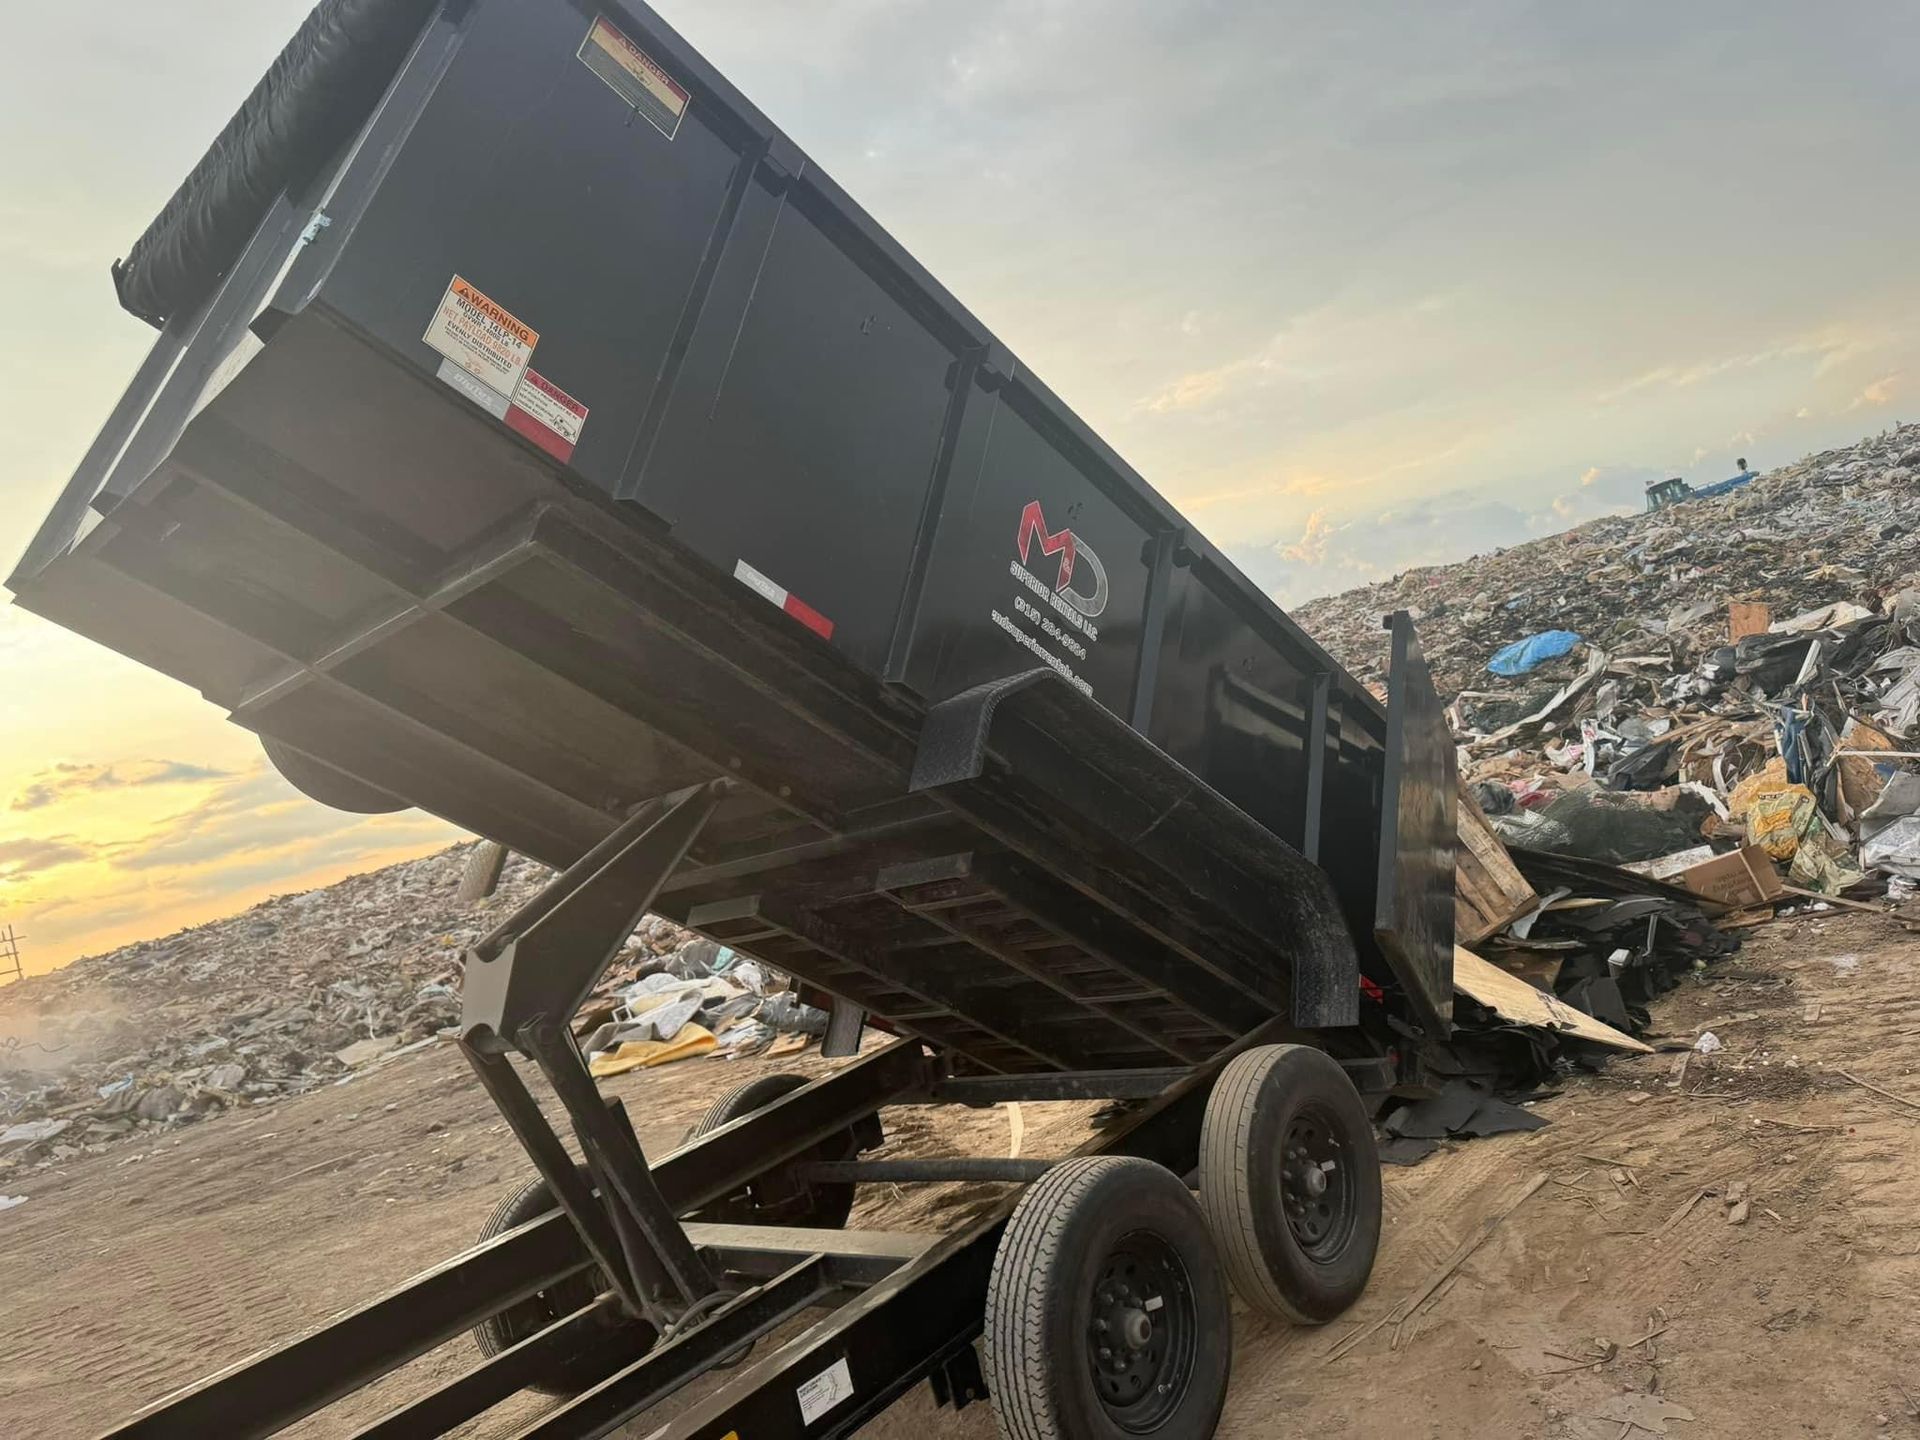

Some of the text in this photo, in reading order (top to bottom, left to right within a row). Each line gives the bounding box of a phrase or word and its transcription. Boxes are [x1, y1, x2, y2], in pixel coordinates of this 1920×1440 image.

[627, 44, 669, 85] DANGER
[442, 305, 458, 321] NET
[457, 316, 492, 346] PAYLOAD
[455, 297, 522, 349] MODEL 14LP-14
[462, 311, 481, 327] GVWR
[469, 292, 530, 341] WARNING
[447, 319, 471, 340] EVENLY
[471, 336, 512, 369] DISTRIBUTED
[541, 381, 577, 412] DANGER
[1010, 560, 1098, 642] SUPERIOR RENTALS LLC
